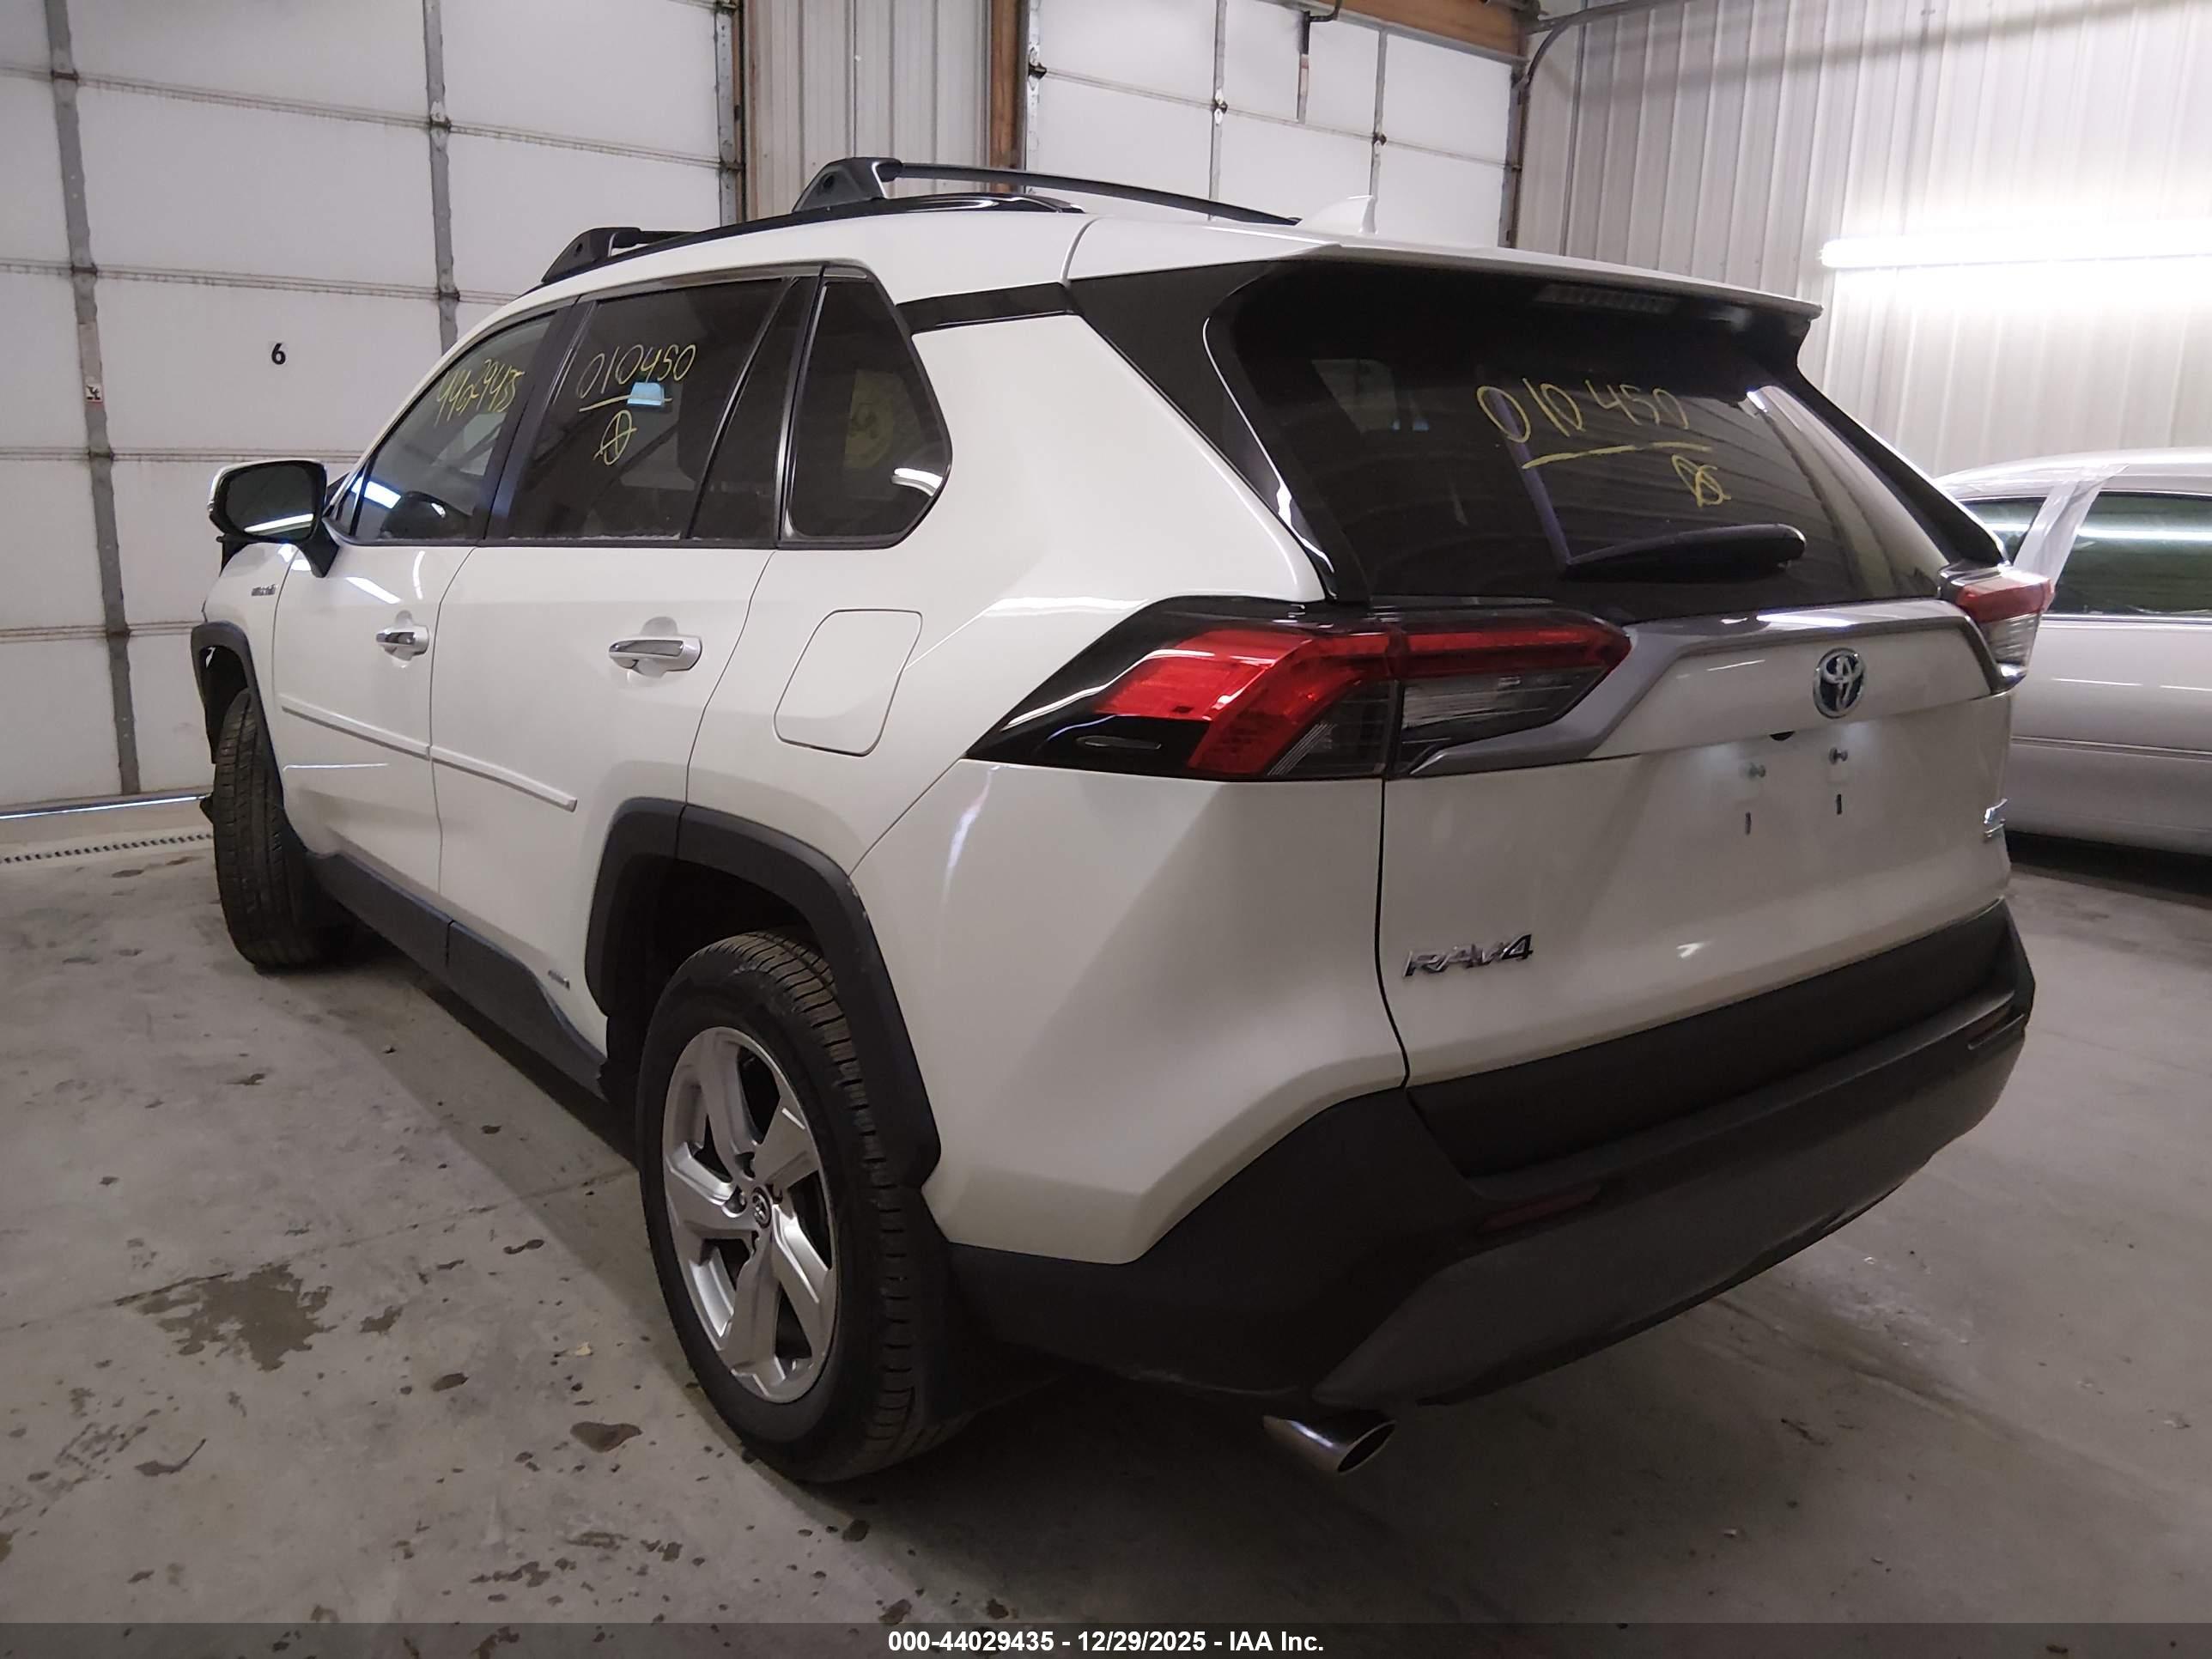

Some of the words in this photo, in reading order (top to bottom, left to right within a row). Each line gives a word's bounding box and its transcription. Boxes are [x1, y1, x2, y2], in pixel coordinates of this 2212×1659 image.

[271, 343, 286, 365] 6
[576, 344, 696, 399] 010450
[1476, 377, 1689, 443] 010450
[1402, 933, 1534, 977] RAV4
